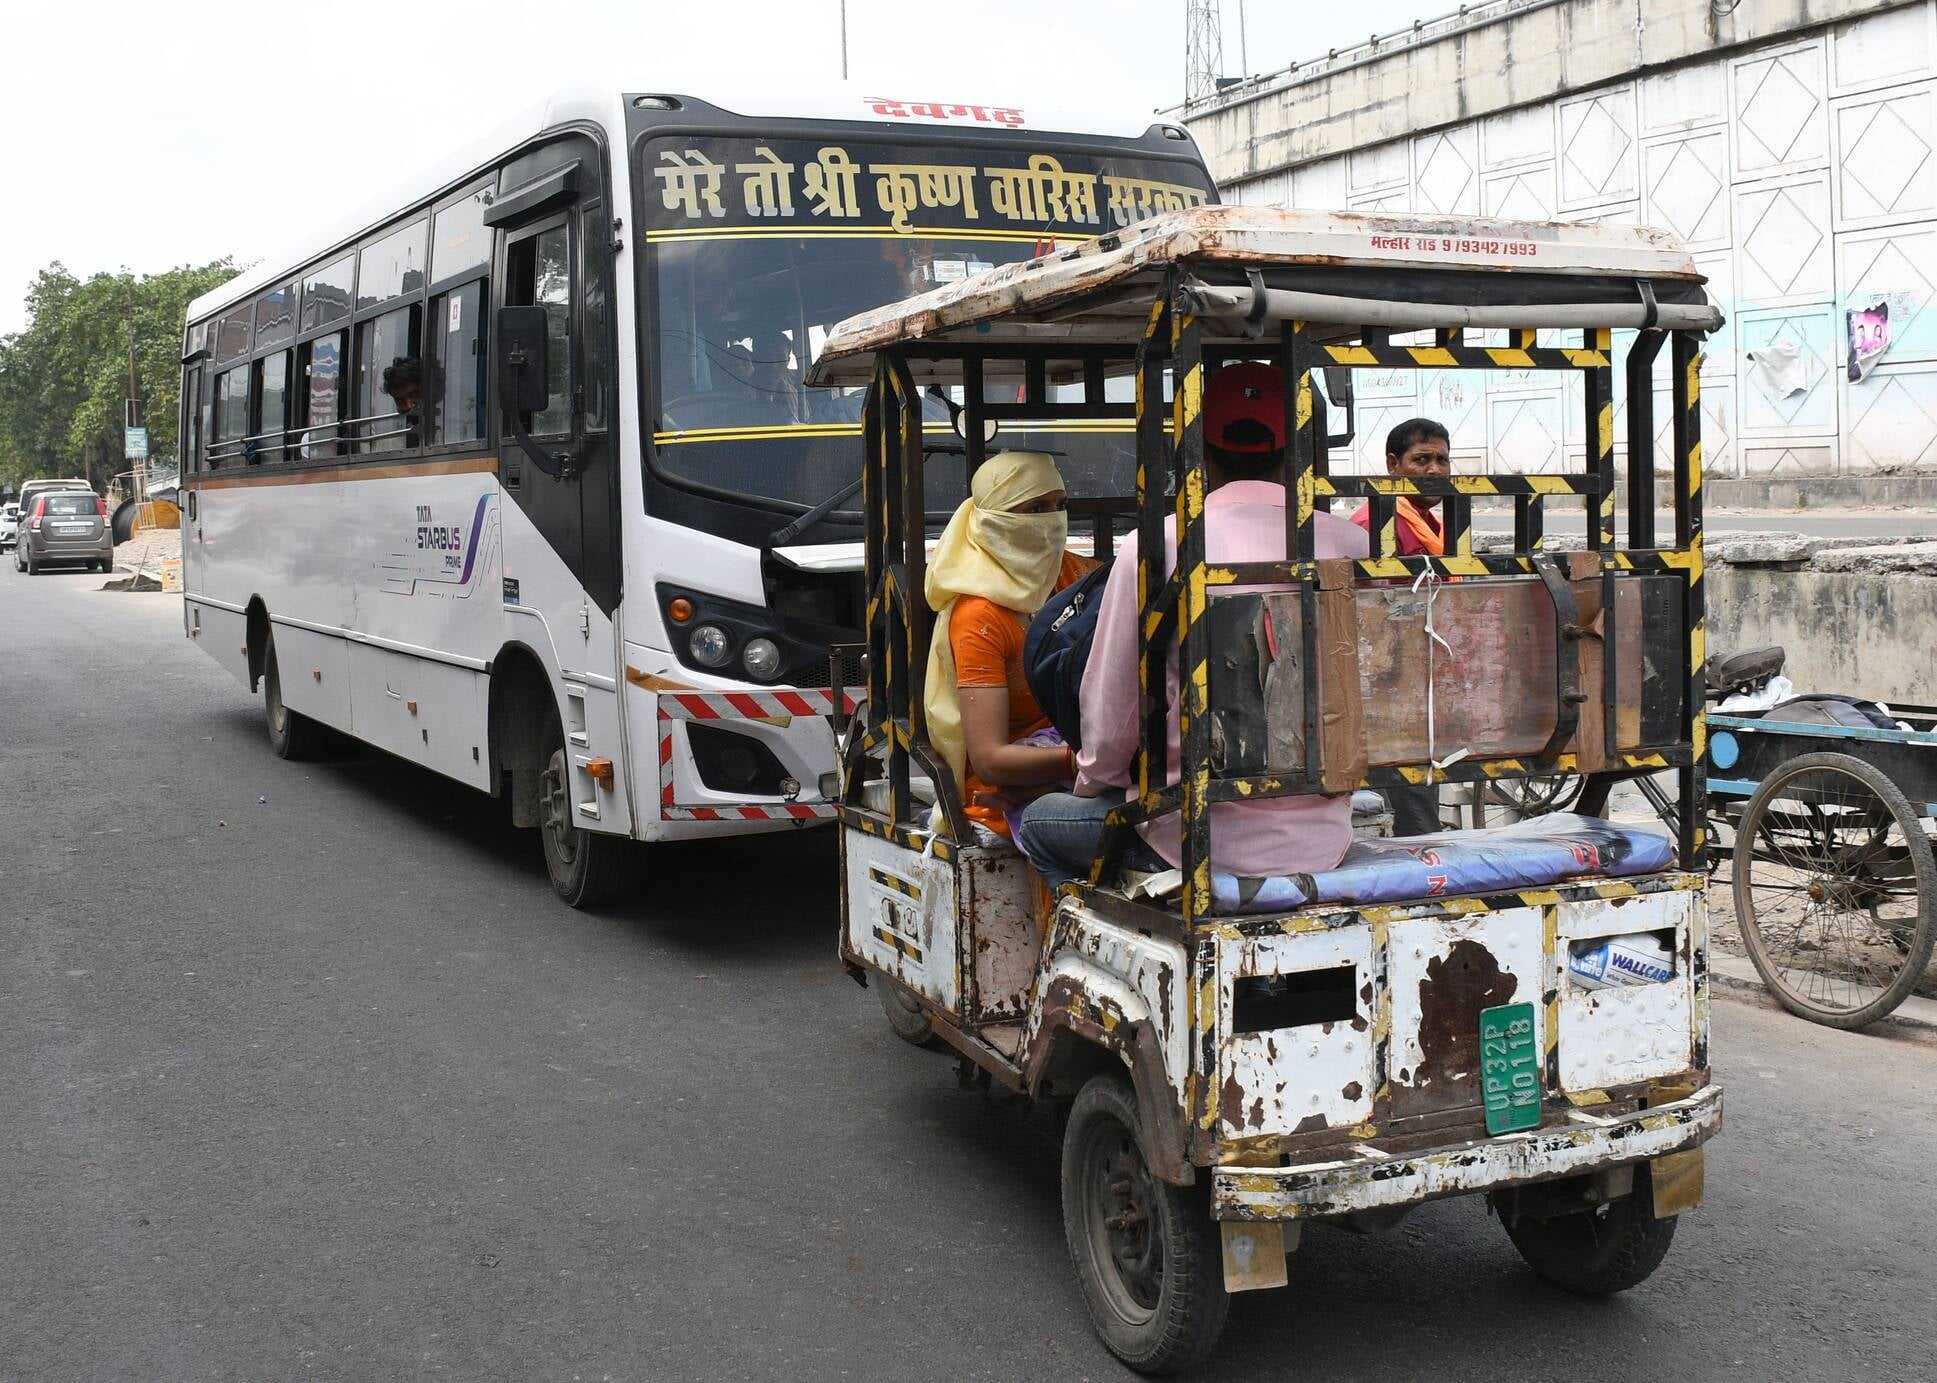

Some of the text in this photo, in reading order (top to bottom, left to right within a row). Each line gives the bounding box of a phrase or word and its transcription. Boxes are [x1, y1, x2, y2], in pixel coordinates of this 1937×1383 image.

[653, 150, 725, 217] मेरे
[735, 147, 795, 217] तो
[802, 147, 861, 217] श्री
[868, 165, 977, 234] कृष्ण
[983, 154, 1100, 225] वारिस
[416, 505, 432, 522] TATA
[417, 527, 461, 550] STARBUS
[1484, 1024, 1510, 1111] UP32P
